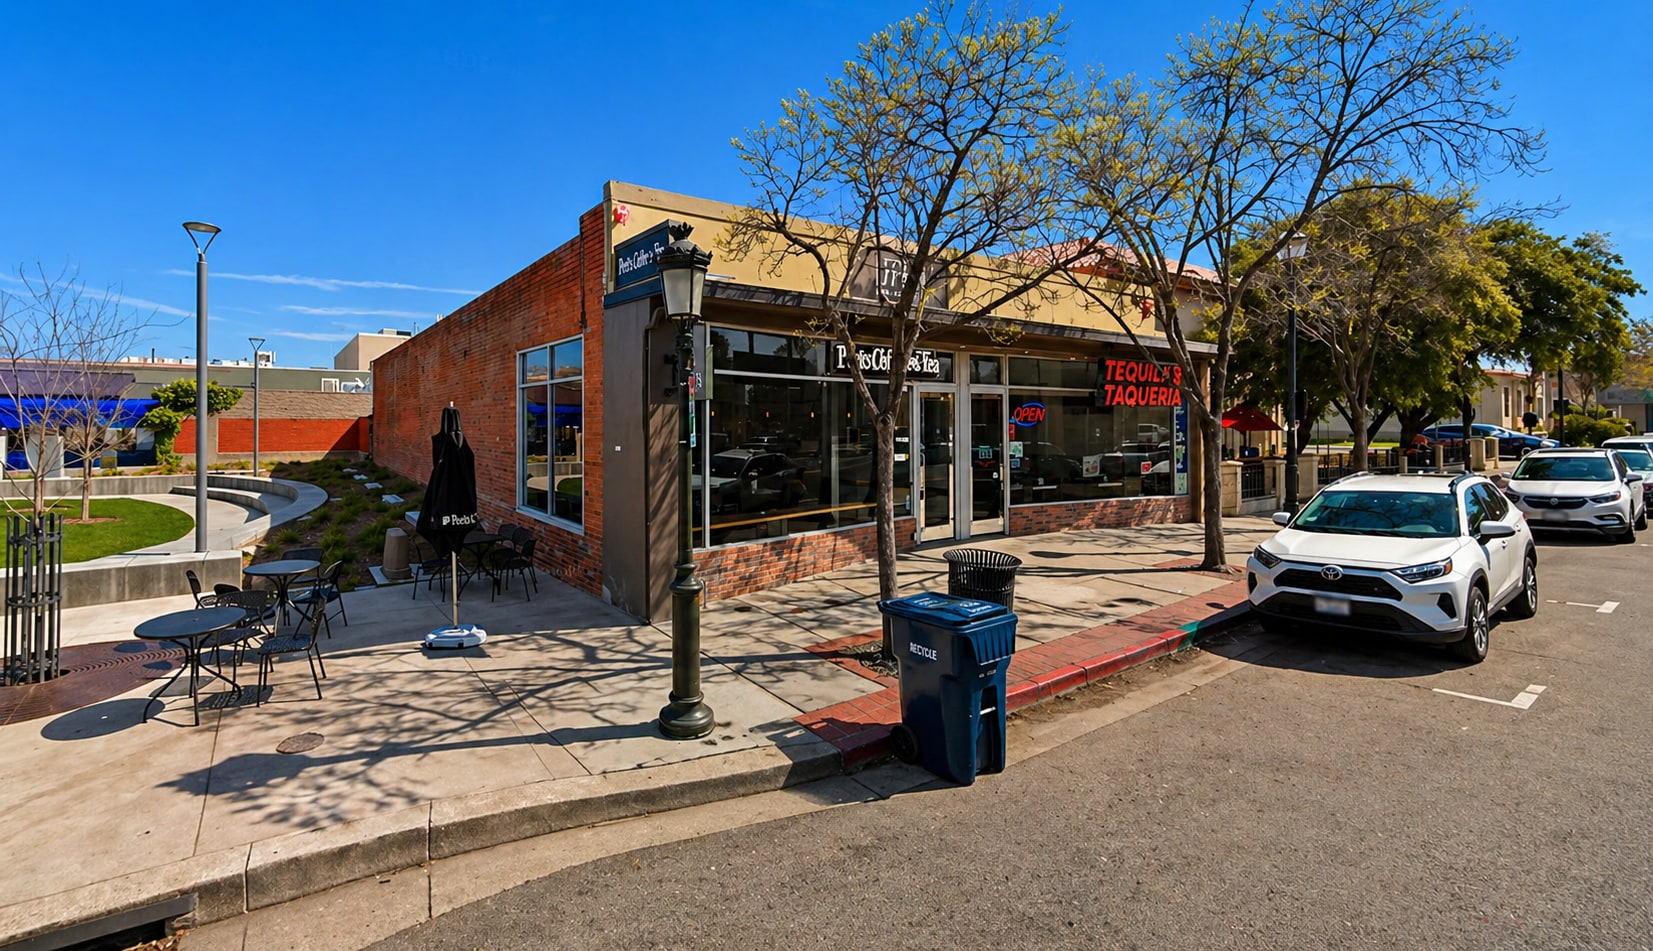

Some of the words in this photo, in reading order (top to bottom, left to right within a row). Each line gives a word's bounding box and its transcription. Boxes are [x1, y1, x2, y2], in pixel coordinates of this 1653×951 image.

[919, 350, 940, 373] Tea
[1104, 384, 1182, 407] TAQUERIA
[1014, 407, 1046, 422] OPEN
[910, 641, 938, 661] RECYCLE
